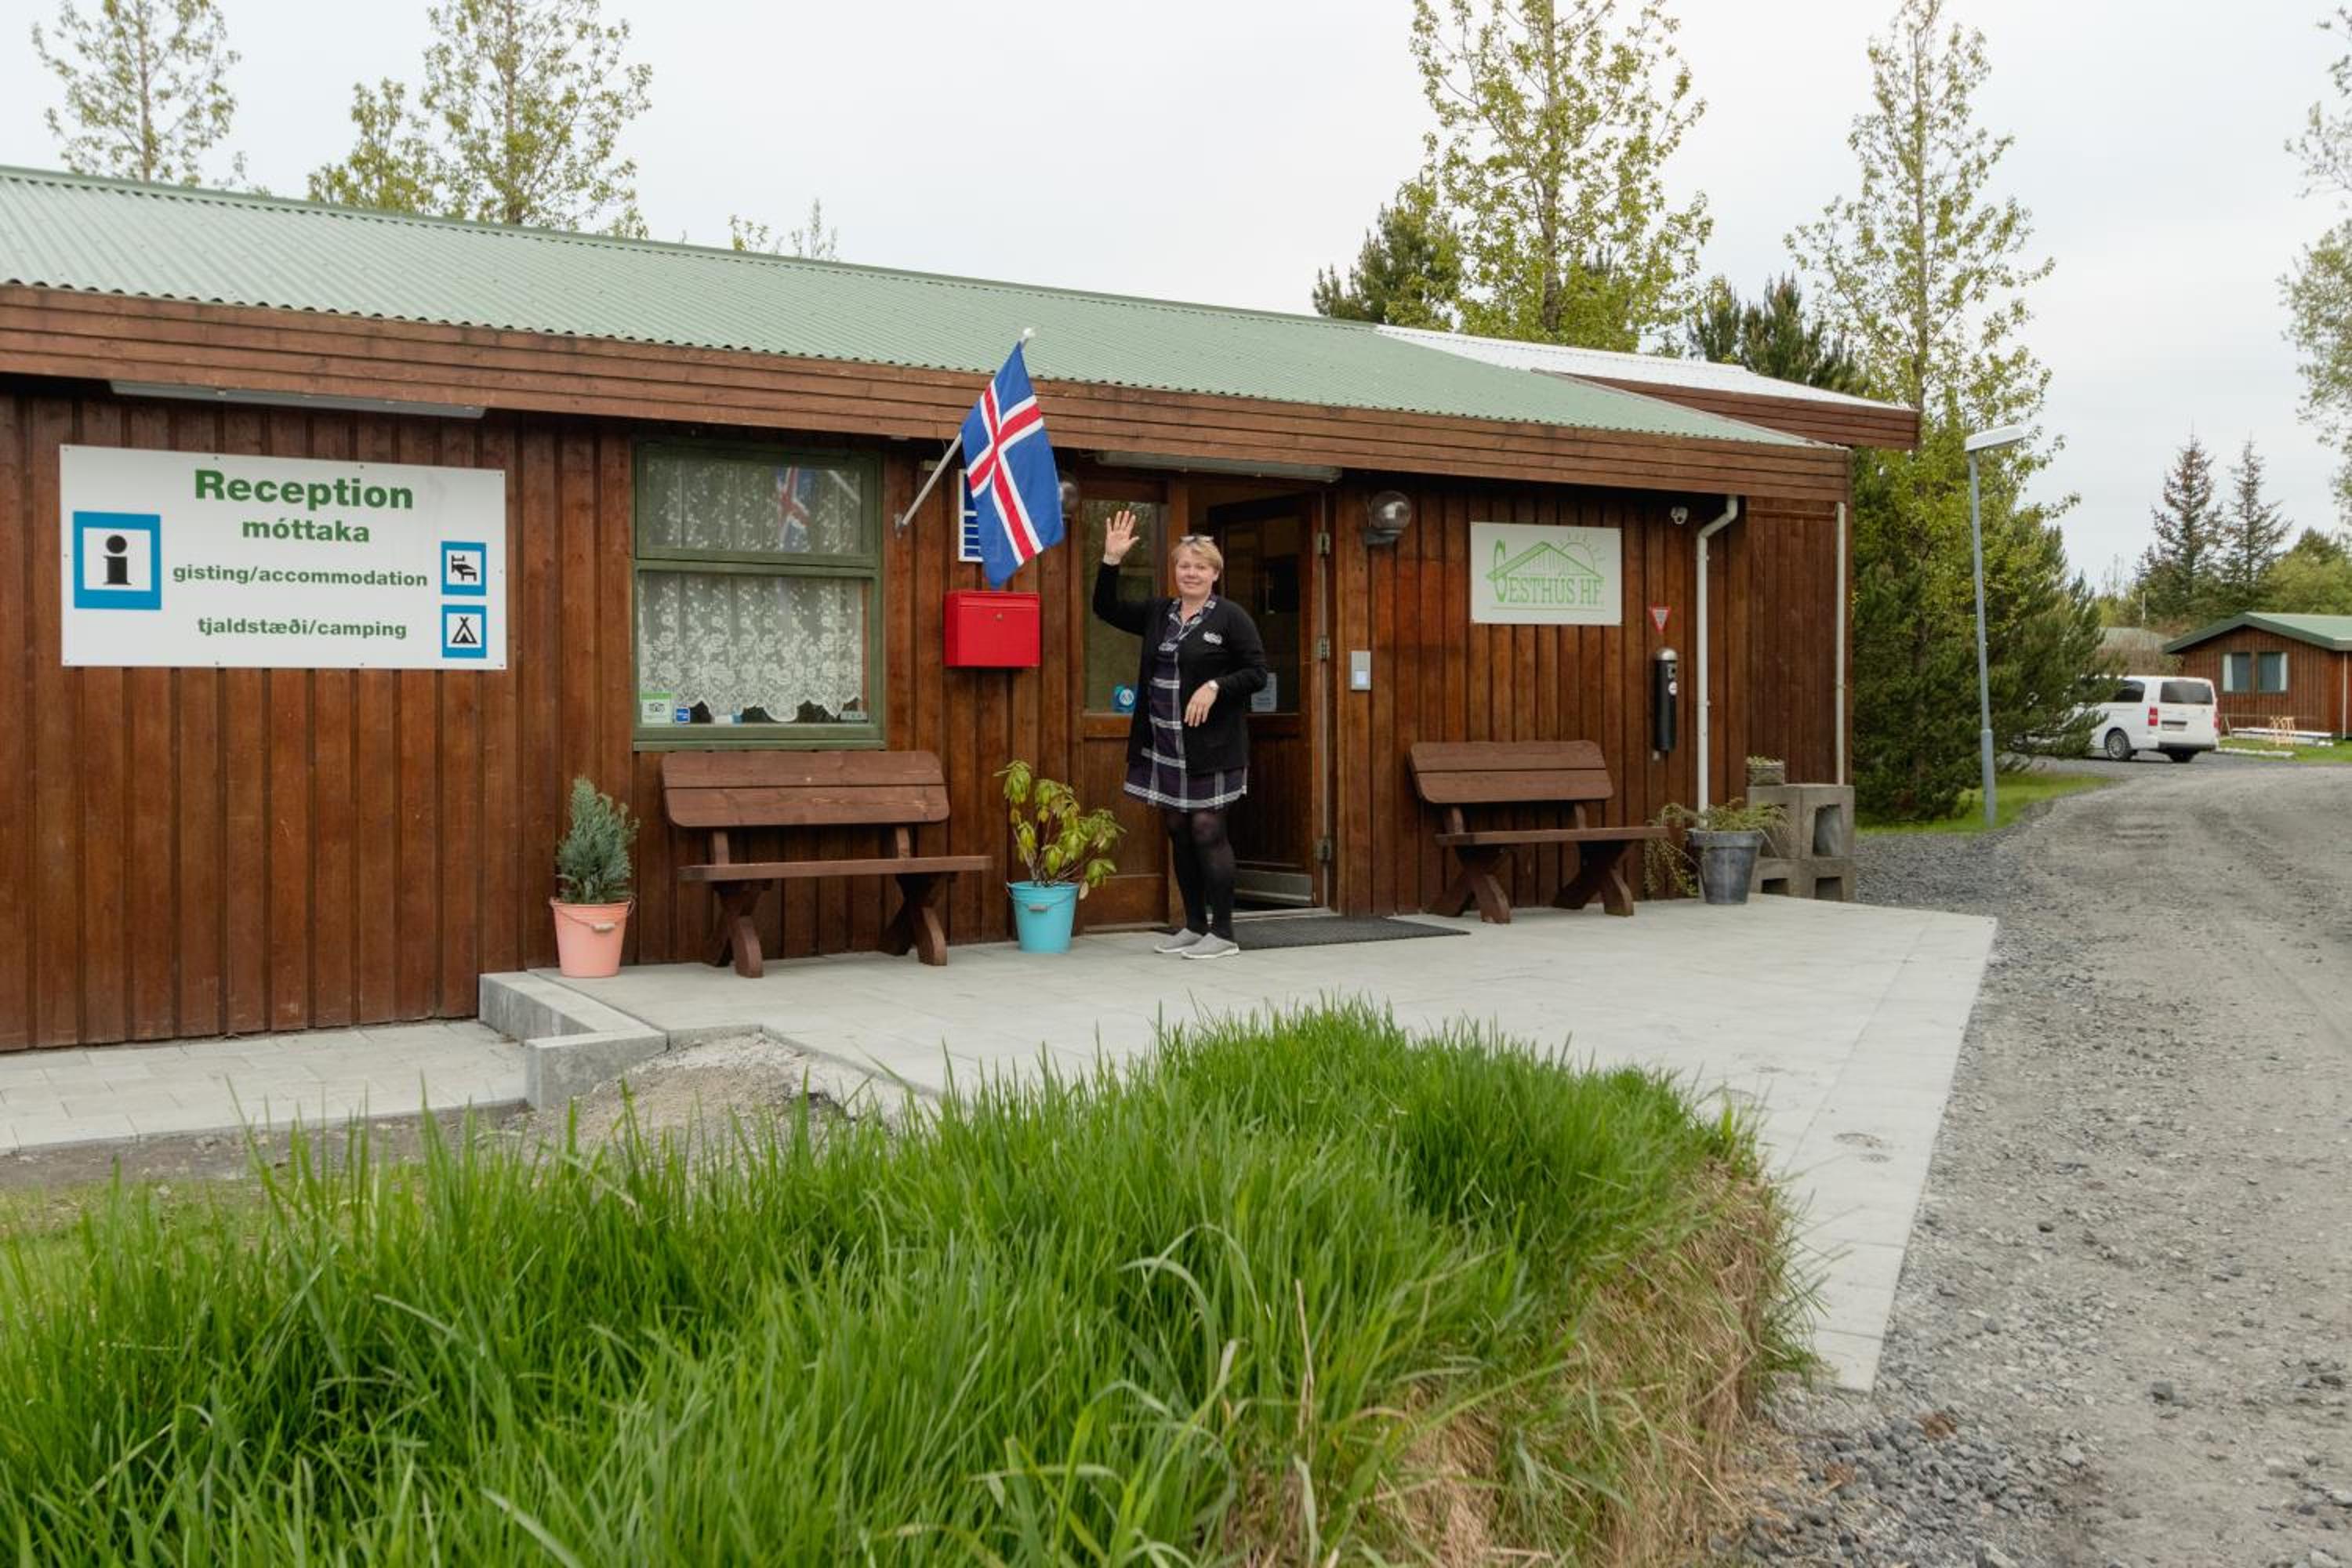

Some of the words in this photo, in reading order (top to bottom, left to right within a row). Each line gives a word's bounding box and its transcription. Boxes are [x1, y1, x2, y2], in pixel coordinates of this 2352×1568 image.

[195, 469, 413, 510] Reception
[242, 517, 369, 543] móttaka
[173, 564, 428, 586] gisting/accommodation
[198, 617, 407, 641] tjaldstæði/camping
